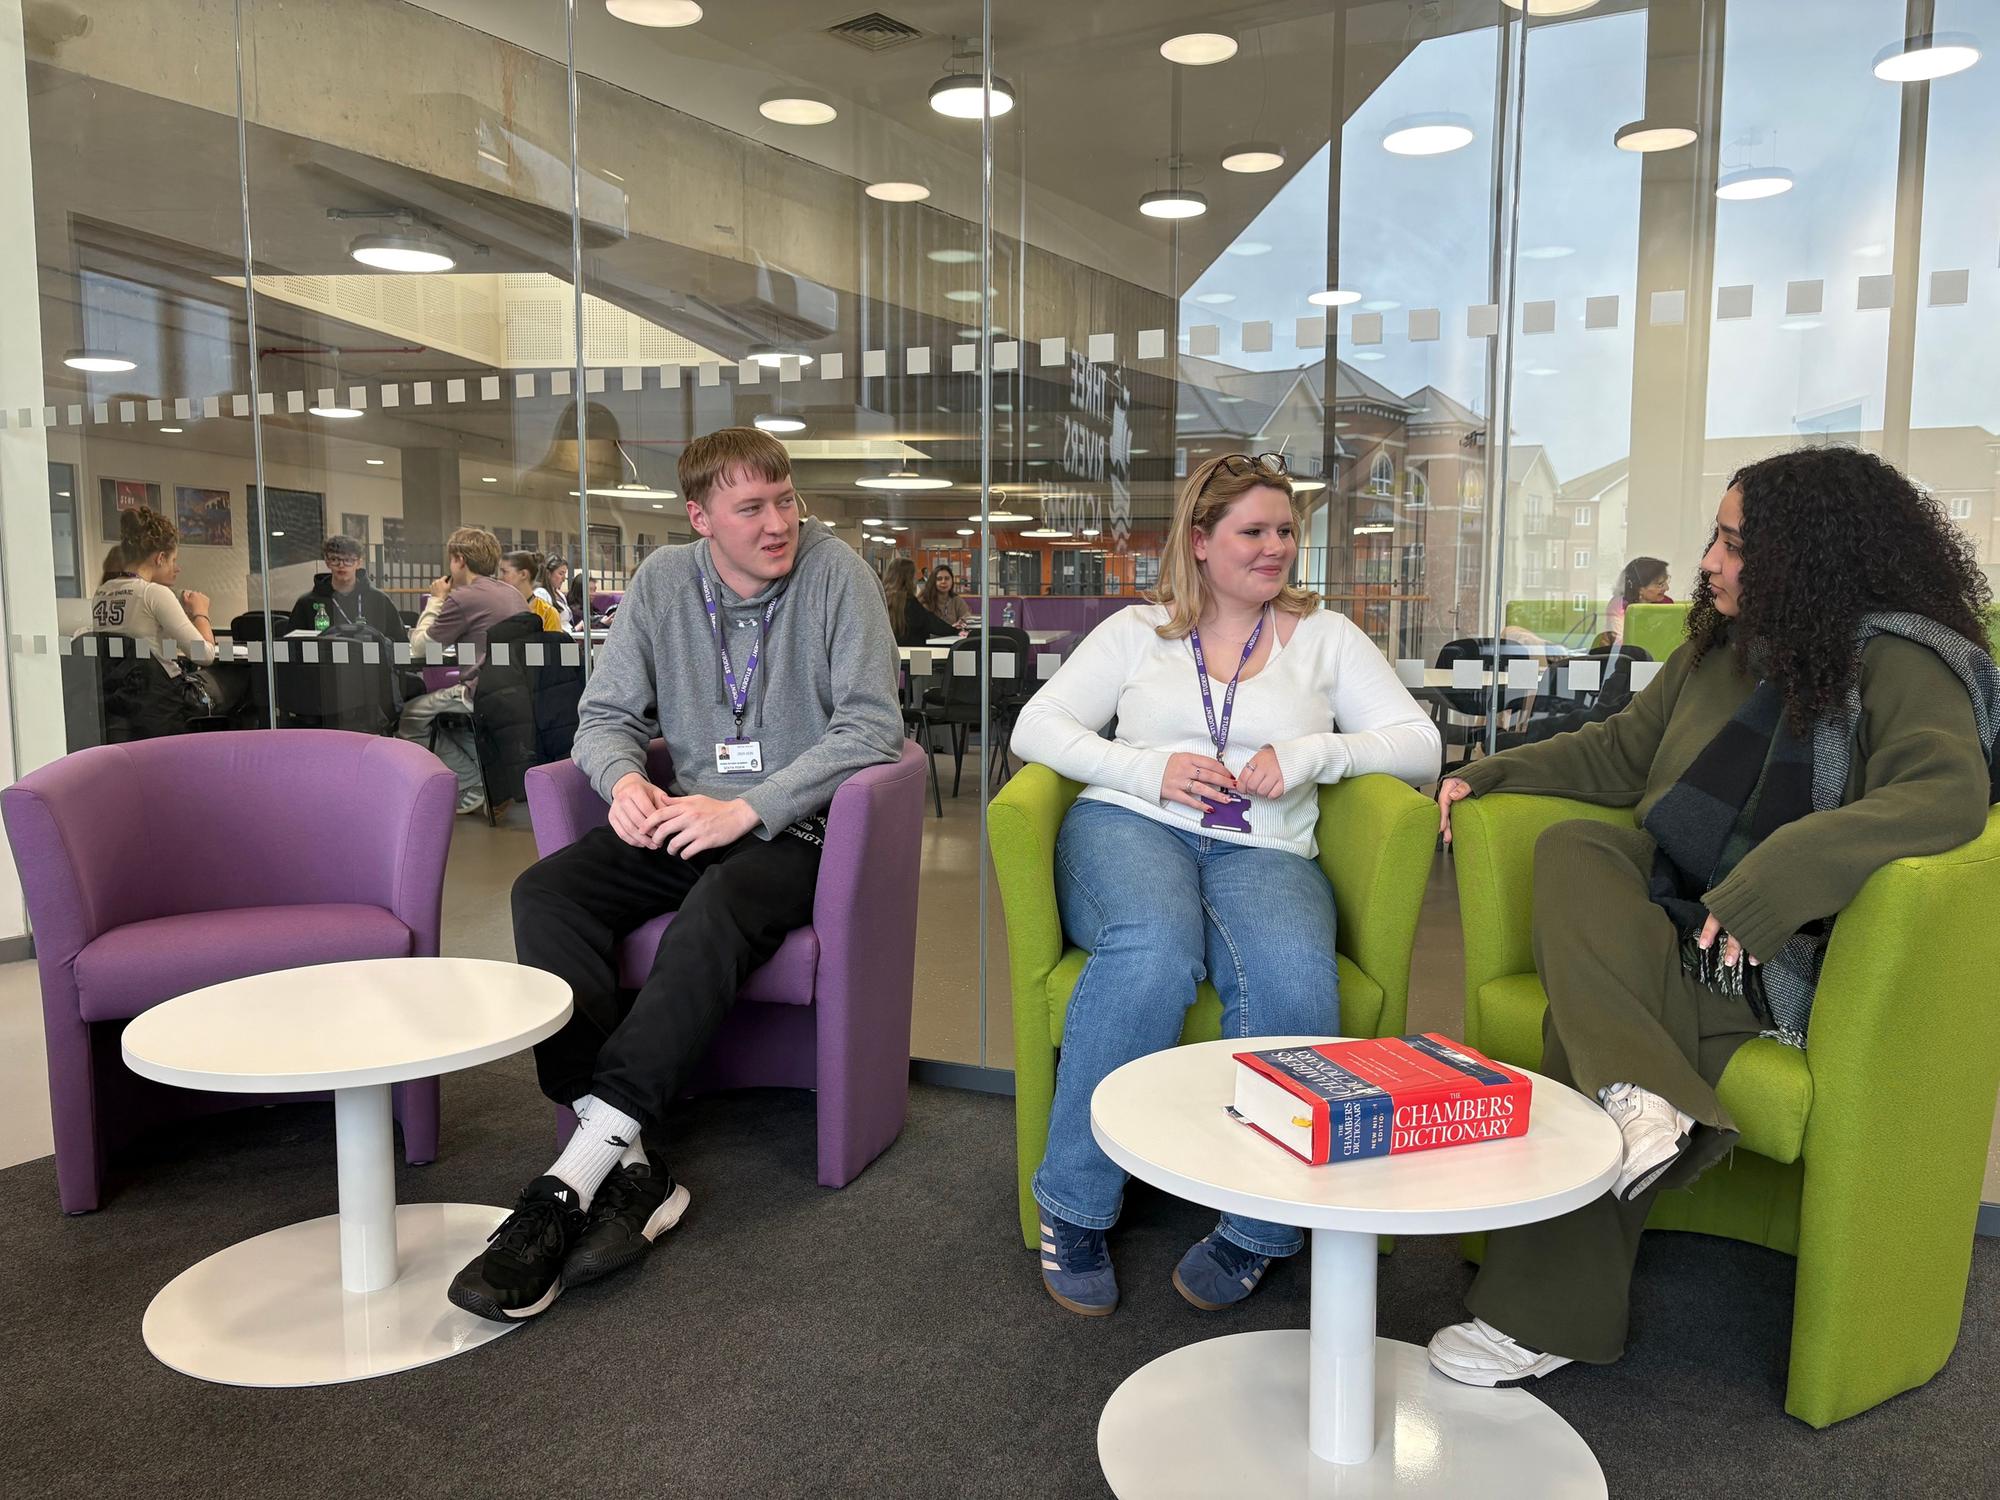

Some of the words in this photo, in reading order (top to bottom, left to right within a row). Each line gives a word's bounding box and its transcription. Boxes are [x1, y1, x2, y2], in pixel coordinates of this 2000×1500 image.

[93, 600, 126, 626] 45
[740, 667, 753, 693] STUDENT
[1200, 673, 1209, 696] STUDENT
[1225, 680, 1236, 705] STUDENT
[1205, 706, 1216, 735] STUDENT
[1219, 716, 1229, 745] STUDENT
[1271, 1051, 1350, 1095] CHAMBERS
[1395, 1095, 1514, 1128] CHAMBERS
[1344, 1102, 1353, 1156] CHAMBERS
[1352, 1102, 1361, 1154] DICTIONARY
[1393, 1118, 1514, 1149] DICTIONARY
